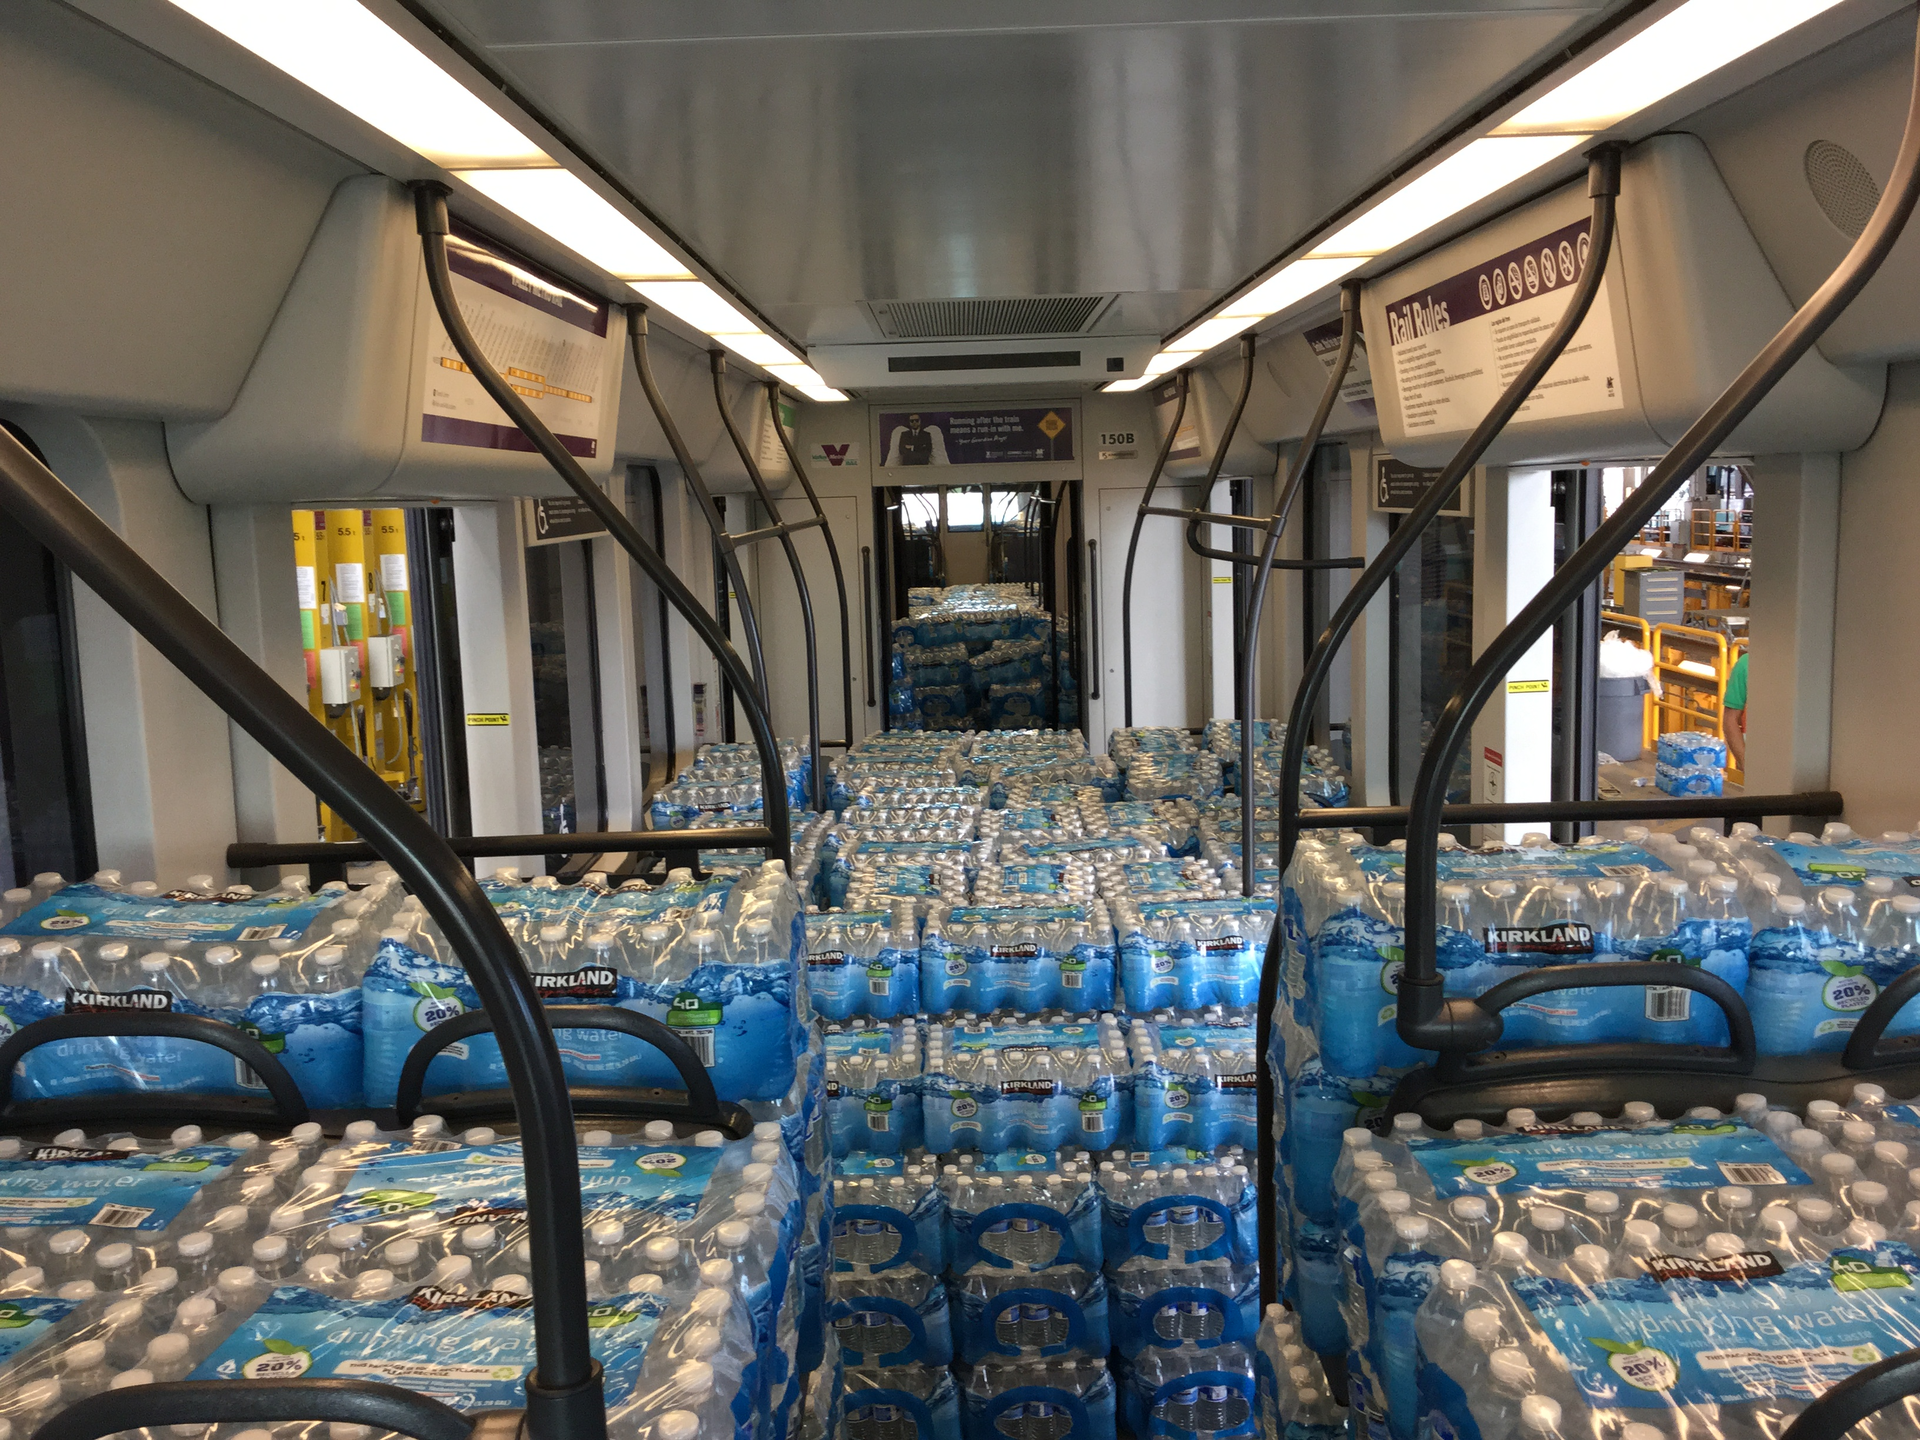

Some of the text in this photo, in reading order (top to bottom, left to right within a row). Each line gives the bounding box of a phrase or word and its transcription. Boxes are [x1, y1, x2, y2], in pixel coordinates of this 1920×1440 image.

[1389, 295, 1451, 345] Rail Rules
[949, 416, 1020, 426] Running after the train
[949, 425, 971, 434] means
[977, 425, 997, 433] run-in
[997, 425, 1012, 433] with
[1100, 432, 1135, 445] 150B
[337, 527, 352, 536] 5.5
[381, 525, 395, 534] 5.5
[50, 917, 84, 926] 20%
[1487, 927, 1591, 943] KIRKLAND
[1197, 937, 1243, 947] KIRKLAND
[807, 952, 844, 960] RKLAND
[948, 960, 966, 971] 20%
[1155, 960, 1172, 969] 20%
[1832, 984, 1871, 1001] 20%
[73, 991, 169, 1010] KIRKLAND
[673, 998, 699, 1010] 40
[424, 1004, 460, 1021] 20%
[1217, 1073, 1257, 1083] KIRKLAN
[1002, 1081, 1052, 1090] KIRKLAND
[1169, 1094, 1187, 1103] 20%
[955, 1104, 975, 1112] 20%
[1473, 1166, 1510, 1178] 20%
[61, 1175, 147, 1189] water
[1651, 1254, 1772, 1273] KIRKLAND
[1833, 1259, 1872, 1273] 40
[256, 1358, 302, 1372] 20%
[1622, 1357, 1667, 1376] 20%
